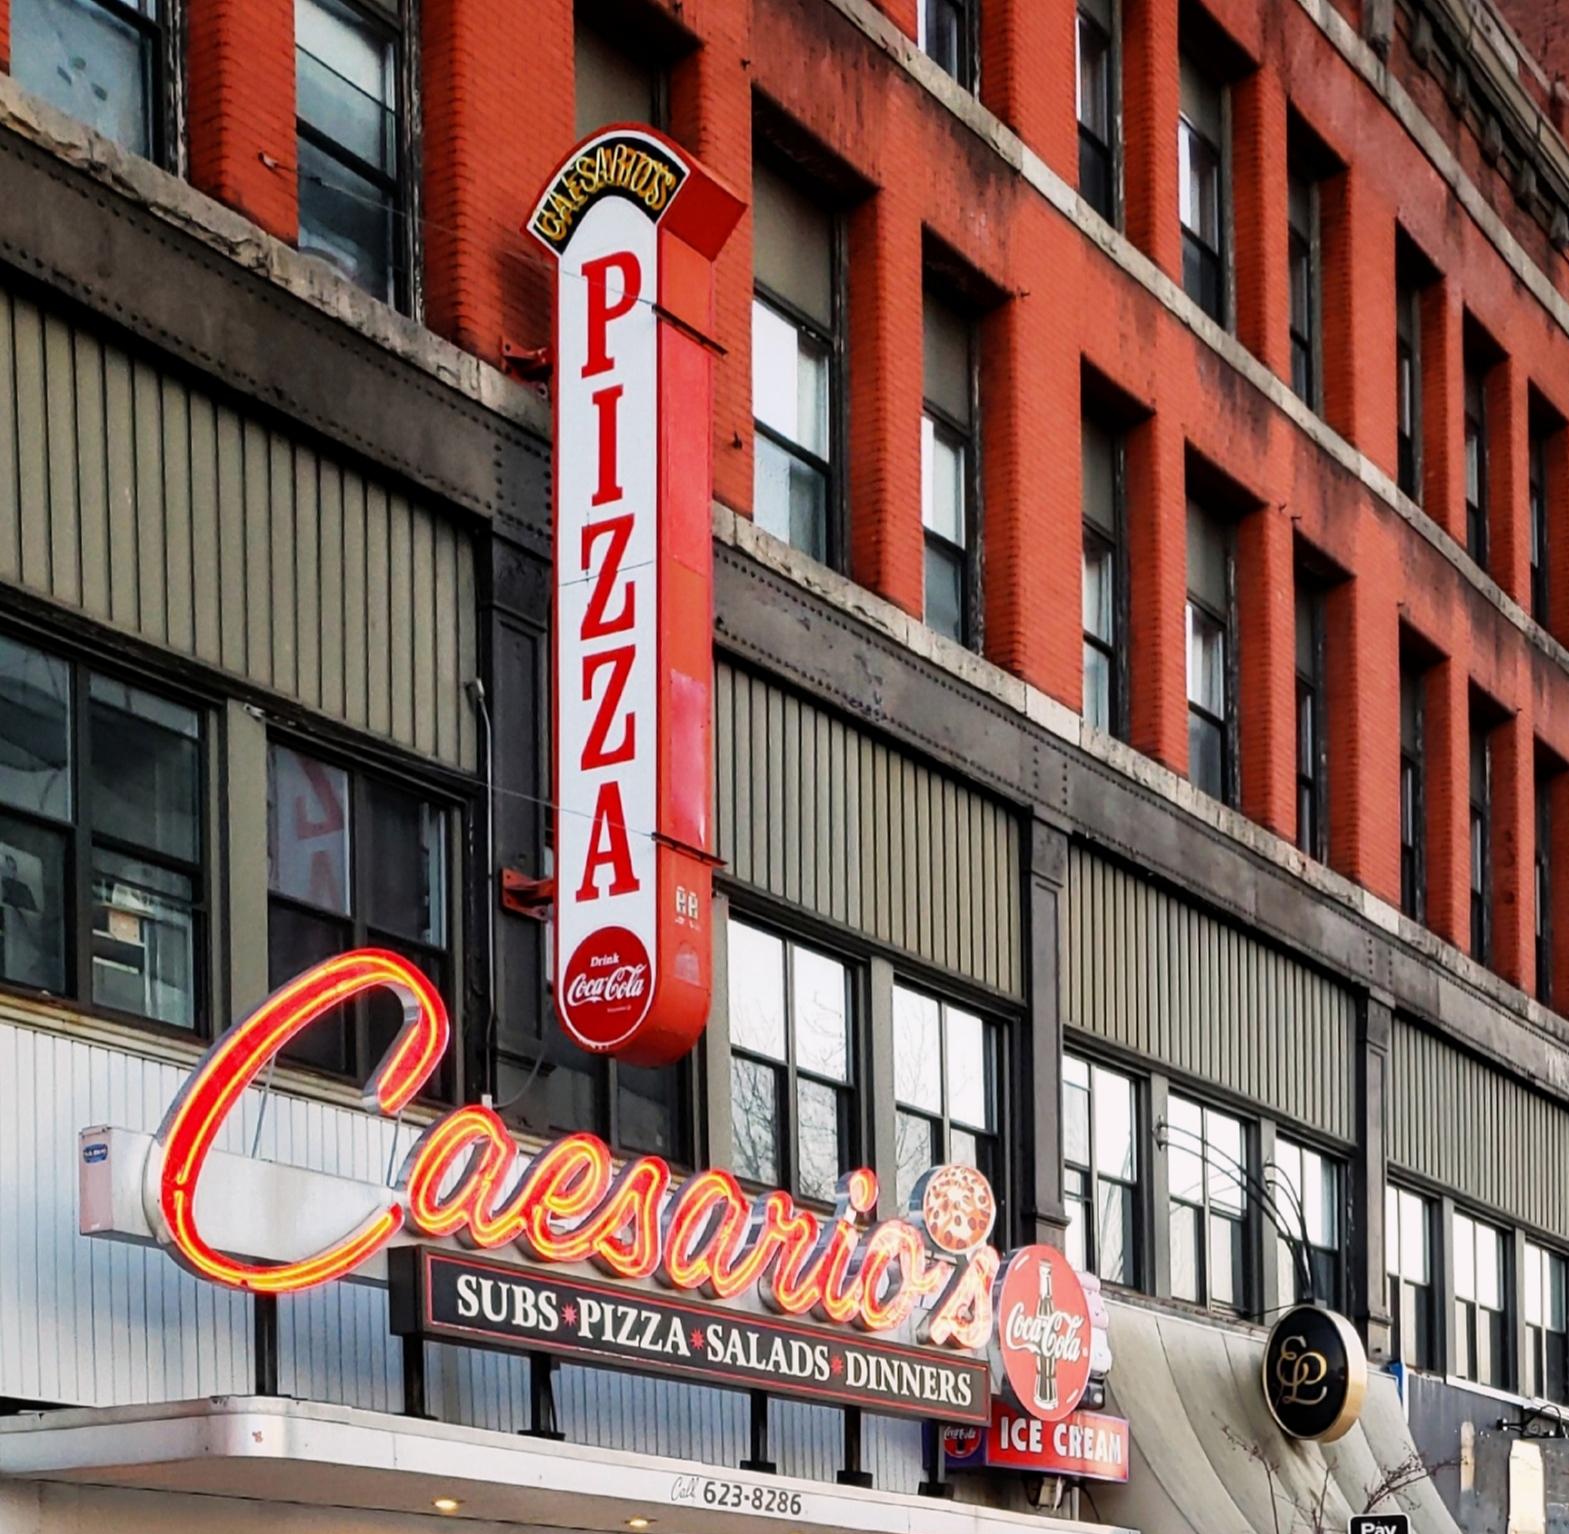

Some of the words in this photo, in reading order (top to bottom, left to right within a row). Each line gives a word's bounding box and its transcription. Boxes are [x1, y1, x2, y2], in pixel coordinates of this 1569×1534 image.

[576, 251, 642, 903] PIZZA
[567, 964, 648, 1007] Coca-Cola
[590, 953, 620, 967] Drink
[457, 1274, 559, 1332] SUBS
[577, 1297, 691, 1357] PIZZA
[706, 1328, 831, 1382] SALADS
[845, 1351, 972, 1406] DINNERS
[1006, 1302, 1084, 1364] Coca-Cola
[1000, 1416, 1043, 1453] ICE
[1053, 1423, 1122, 1464] CREAM
